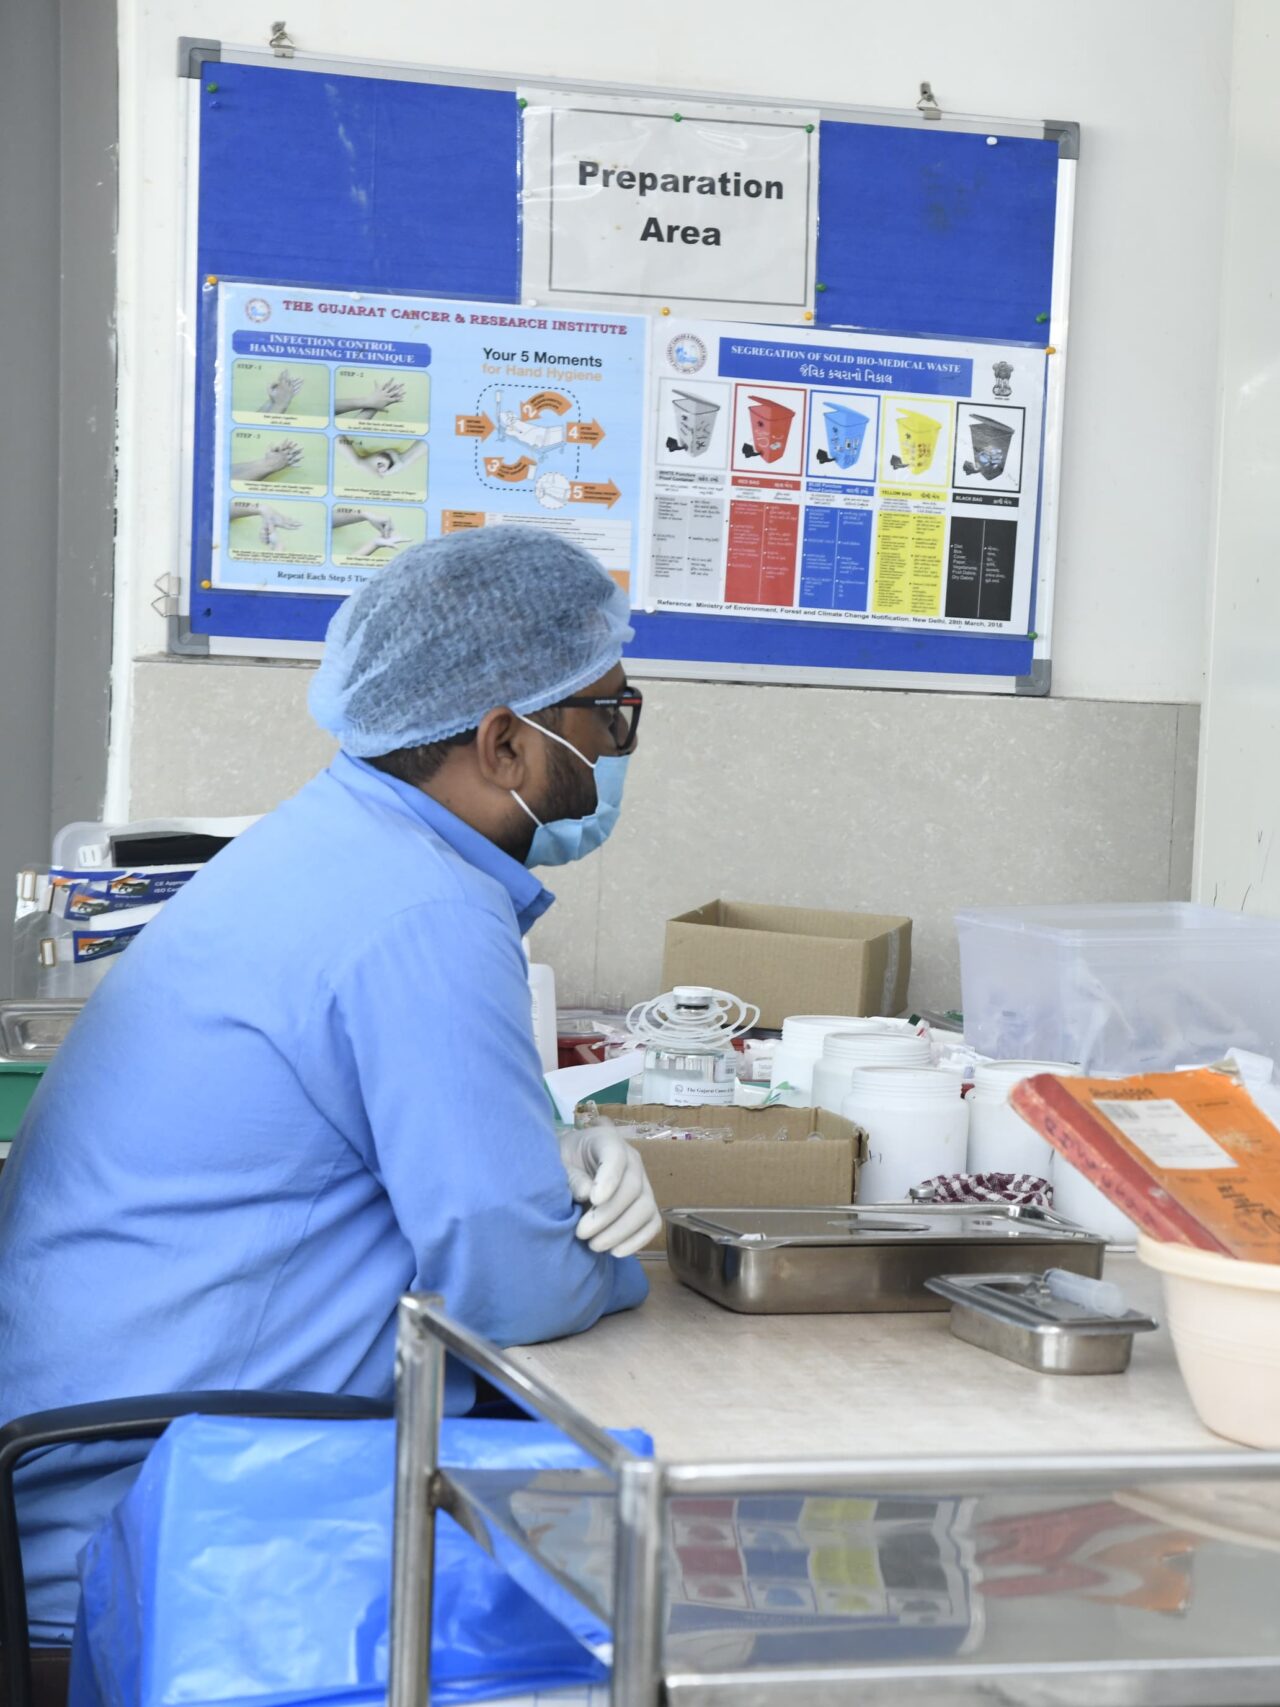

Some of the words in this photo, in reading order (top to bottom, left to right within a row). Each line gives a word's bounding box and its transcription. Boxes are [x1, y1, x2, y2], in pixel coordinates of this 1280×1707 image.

[578, 160, 783, 200] Preparation
[640, 217, 722, 246] Area
[282, 300, 314, 313] THE
[318, 303, 387, 318] GUJARAT
[391, 308, 450, 322] CANCER
[455, 313, 466, 324] &
[470, 314, 548, 330] RESEARCH
[552, 320, 628, 336] INSTITUTE
[270, 334, 336, 348] INFECTION
[337, 339, 396, 352] CONTROL
[250, 343, 284, 353] HAND
[286, 346, 342, 358] WASHING
[344, 350, 415, 364] TECHNIQUE
[483, 348, 516, 362] Your
[520, 350, 530, 362] 5
[534, 351, 603, 368] Moments
[731, 345, 805, 361] SEGREGATION
[807, 352, 823, 361] OF
[823, 353, 854, 364] SOLID
[856, 357, 925, 371] BIO-MEDICAL
[927, 362, 961, 373] WASTE
[481, 363, 501, 375] for
[505, 364, 543, 378] Hand
[547, 367, 603, 382] Hygiene
[522, 405, 537, 418] 2
[456, 419, 465, 433] 1
[568, 425, 579, 438] 4
[487, 459, 500, 472] 3
[572, 485, 583, 499] 5
[277, 570, 304, 582] Repeat
[306, 572, 327, 581] Each
[328, 573, 346, 583] Step
[347, 574, 353, 582] 5
[695, 602, 723, 610] Ministry
[818, 610, 842, 618] Climate
[844, 612, 870, 620] Change
